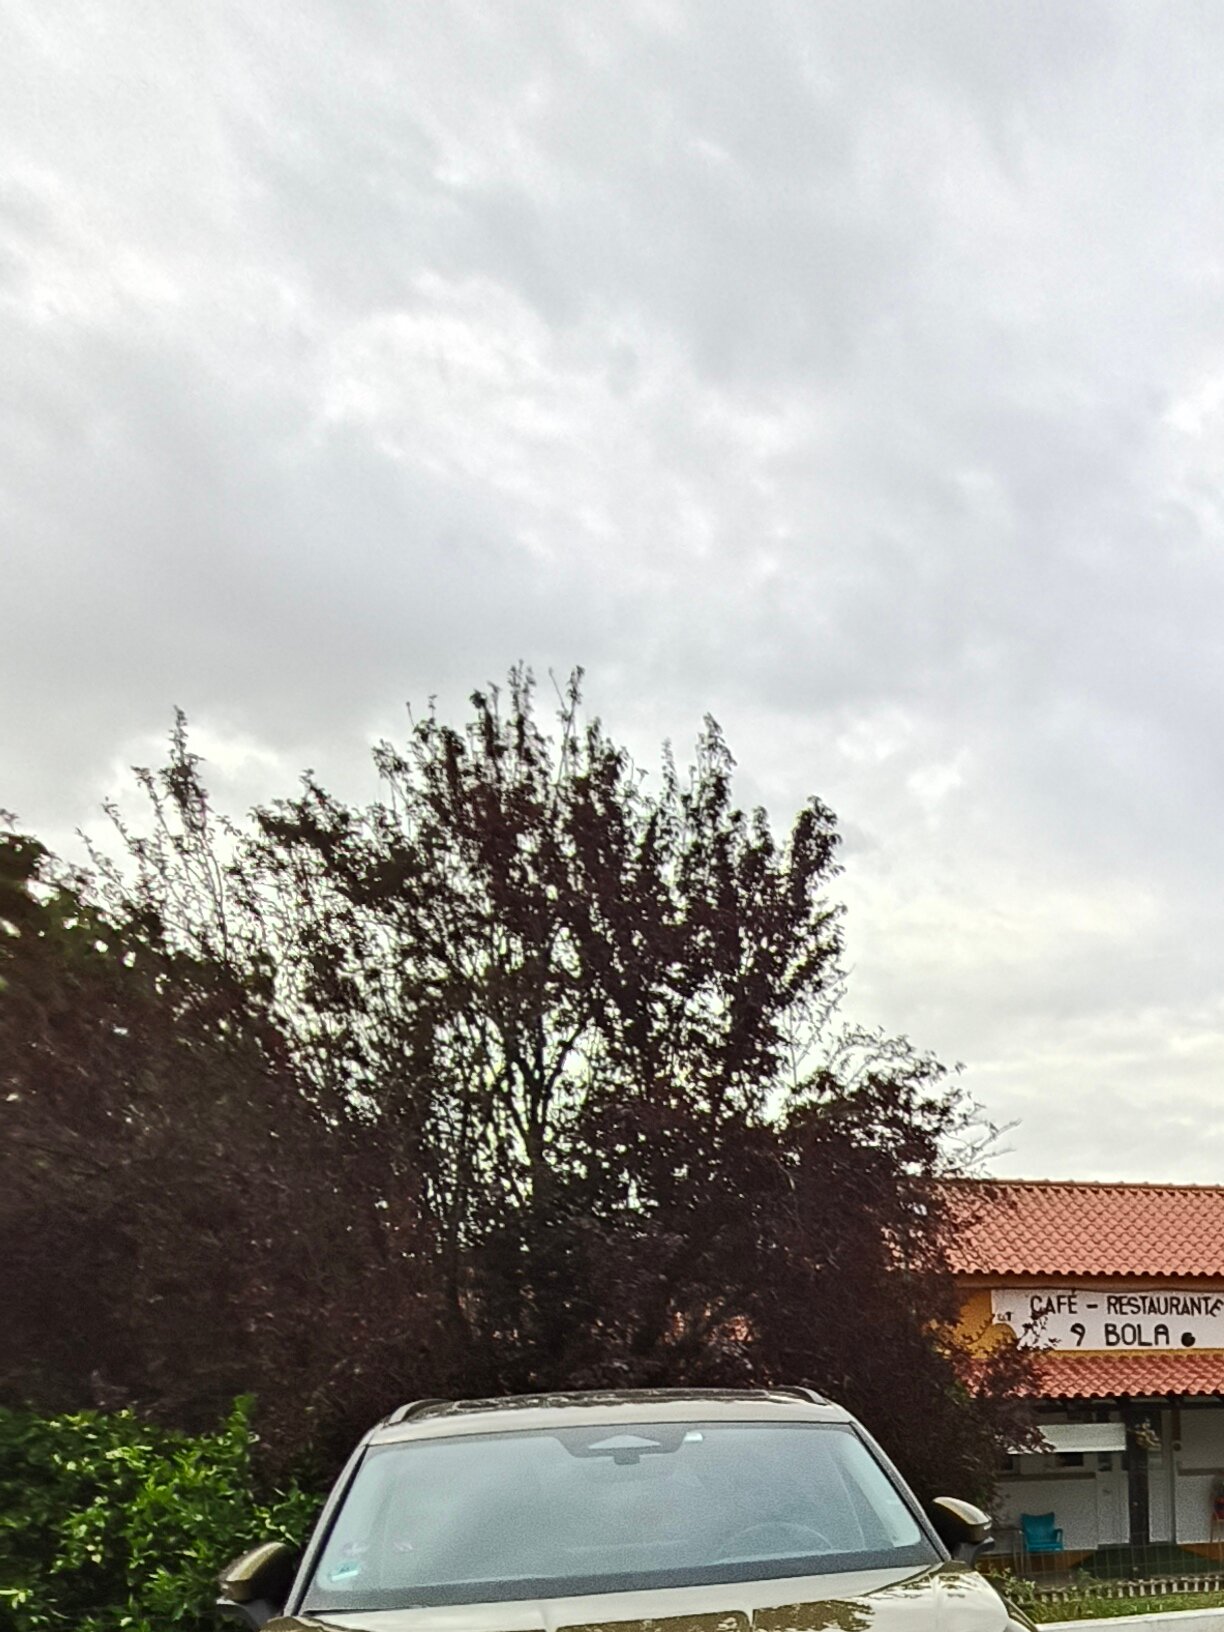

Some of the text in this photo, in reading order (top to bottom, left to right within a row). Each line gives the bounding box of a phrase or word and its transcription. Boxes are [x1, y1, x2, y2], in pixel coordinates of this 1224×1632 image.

[1030, 1289, 1078, 1315] CAFÉ
[1107, 1295, 1224, 1317] RESTAURANTE
[1104, 1322, 1171, 1347] BOLA
